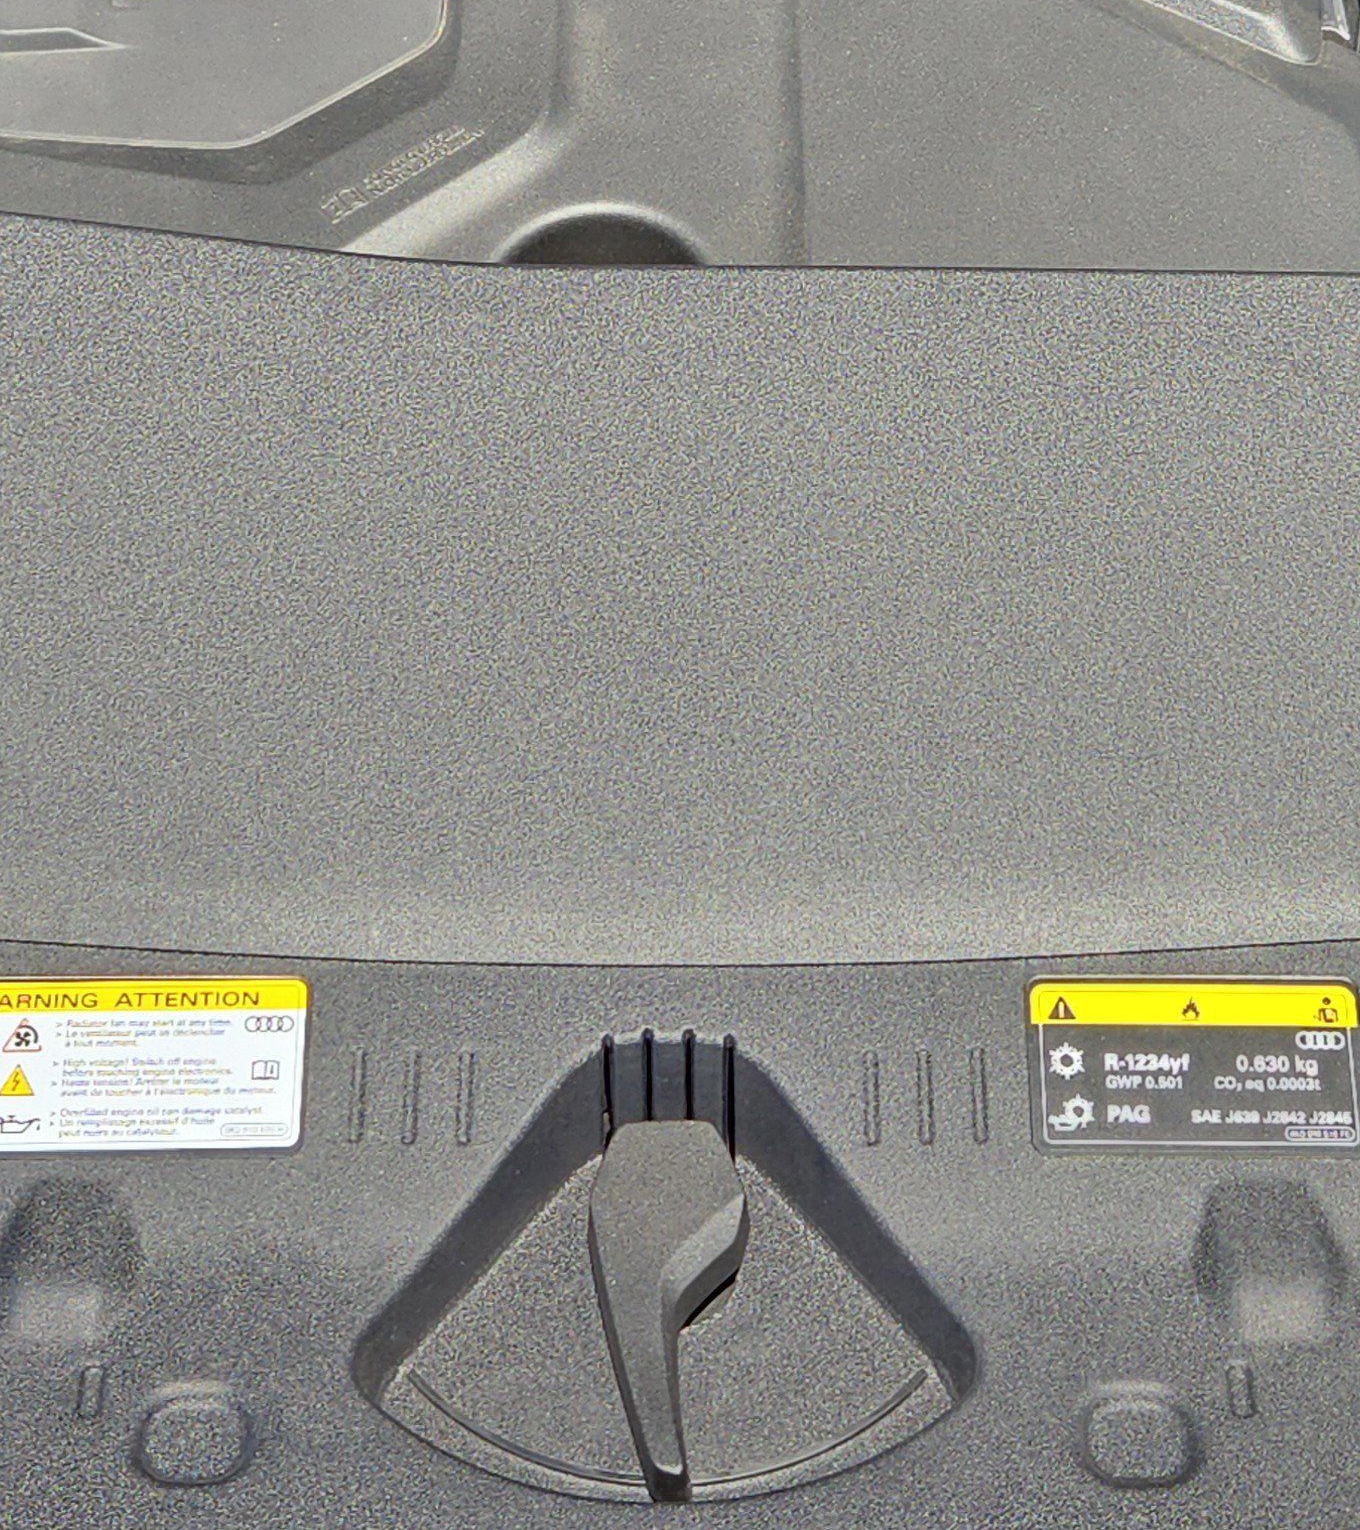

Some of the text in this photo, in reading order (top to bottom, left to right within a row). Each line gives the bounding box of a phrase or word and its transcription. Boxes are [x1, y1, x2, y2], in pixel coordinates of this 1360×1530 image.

[115, 991, 260, 1008] ATTENTION
[1104, 1053, 1319, 1076] R-1234yf 0.630 kg
[1105, 1076, 1142, 1089] GWP
[1107, 1104, 1152, 1123] PAG
[1191, 1109, 1222, 1124] SAE
